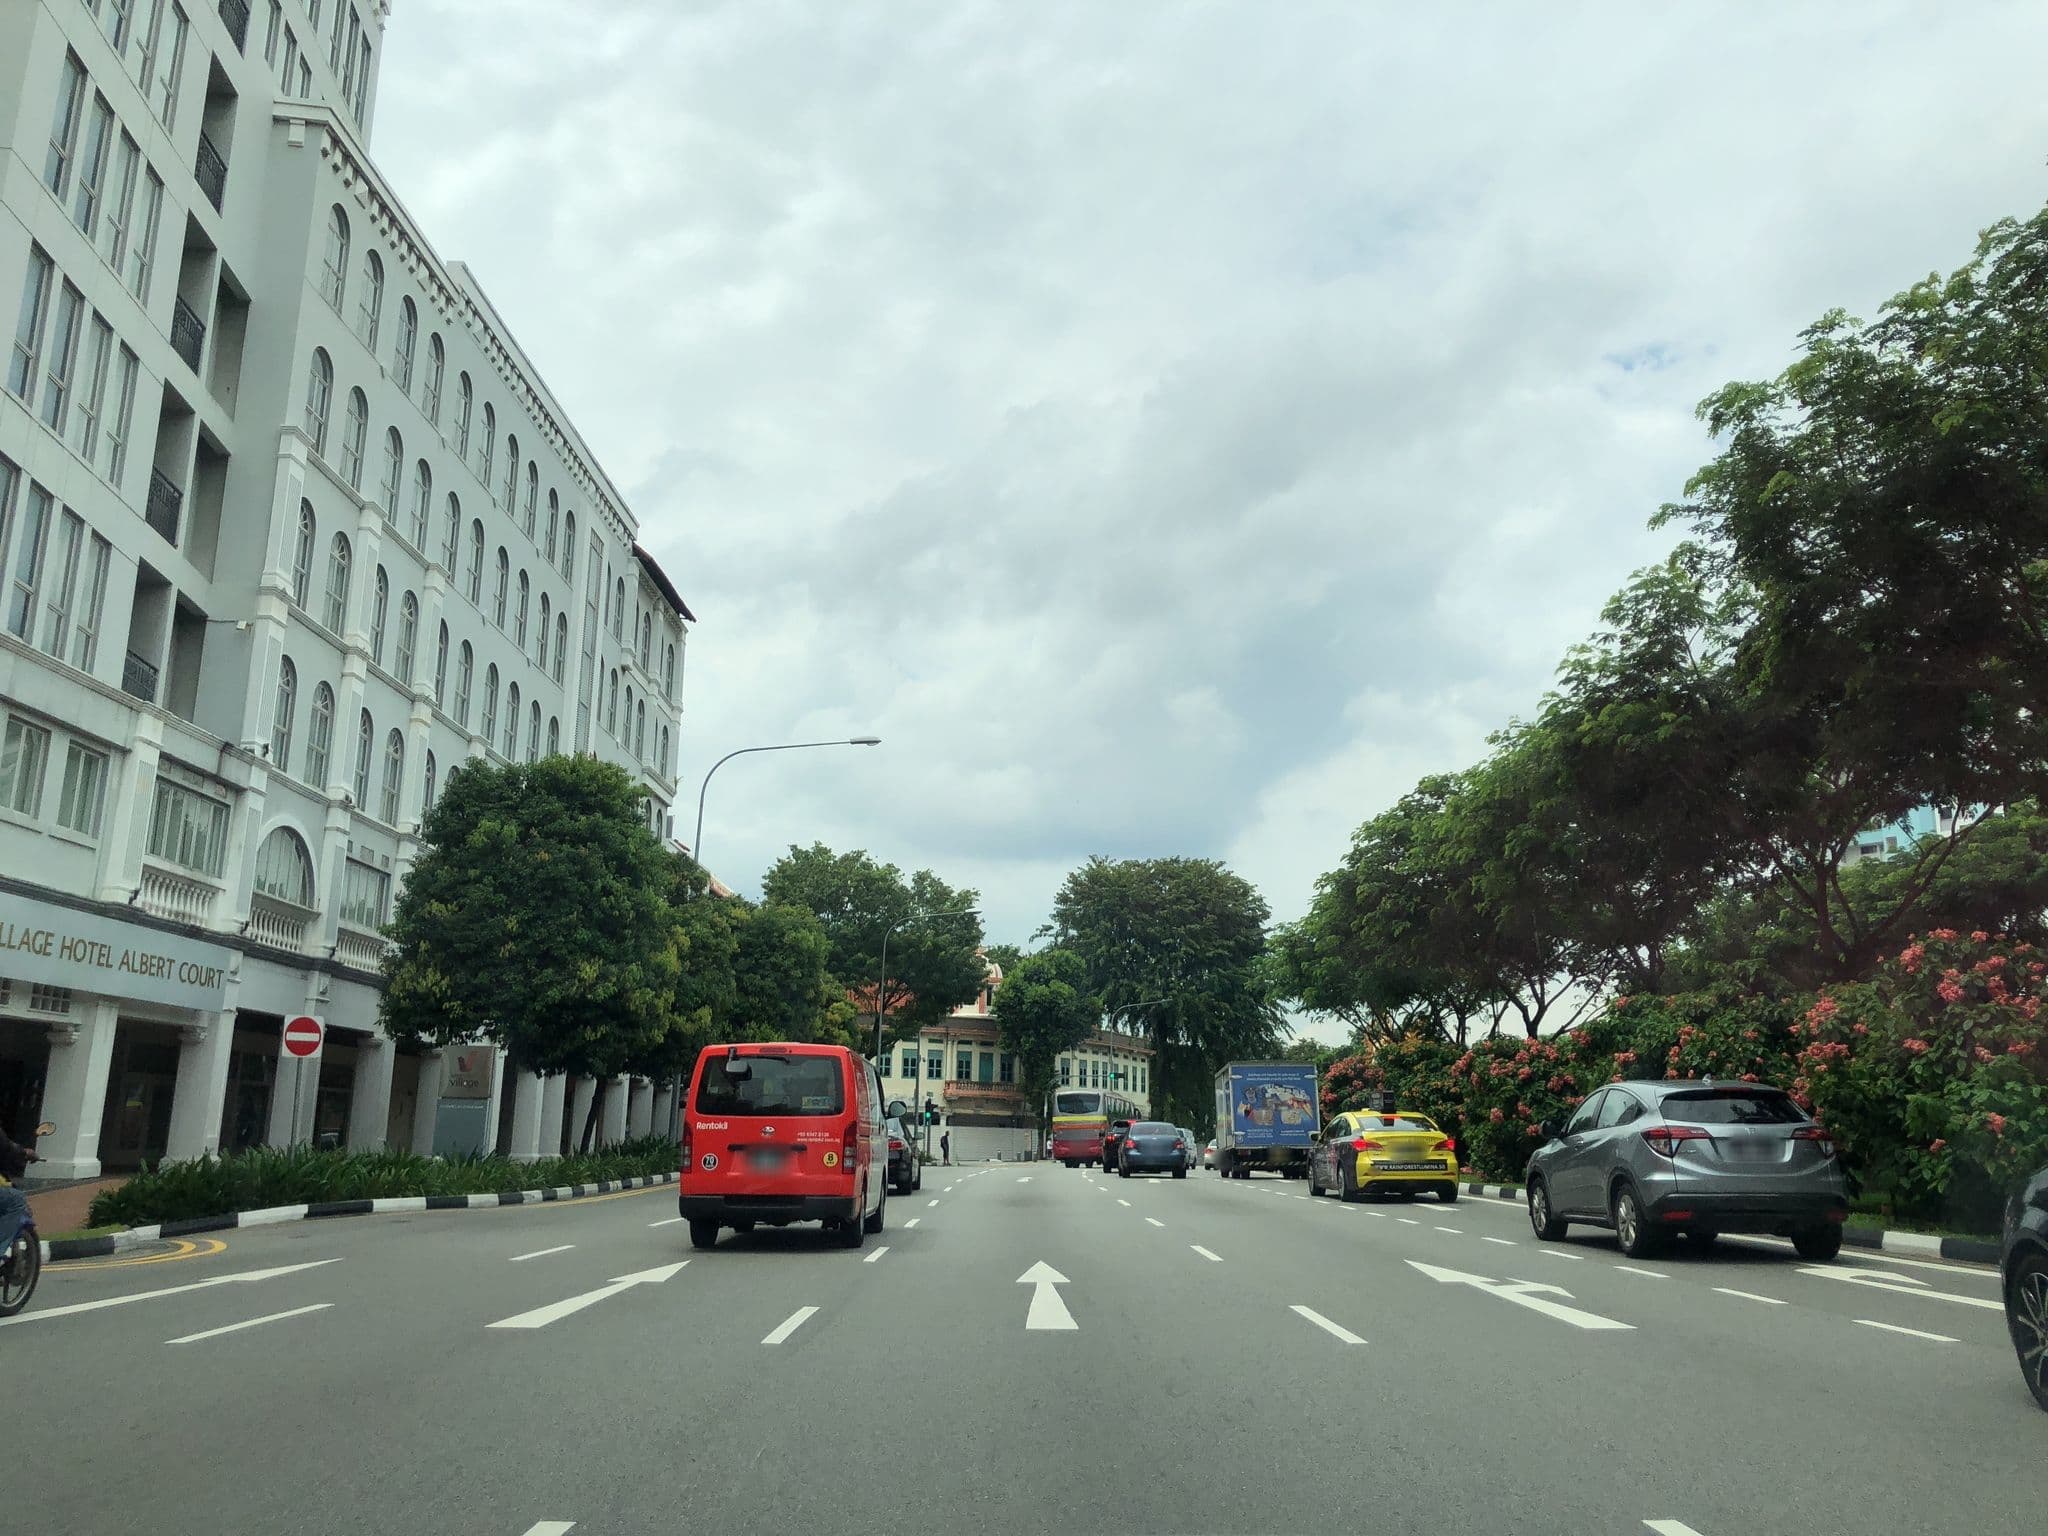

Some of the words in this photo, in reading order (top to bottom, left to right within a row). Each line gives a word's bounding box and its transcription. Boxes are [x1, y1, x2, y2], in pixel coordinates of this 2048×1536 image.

[60, 935, 113, 969] HOTEL
[118, 949, 175, 980] ALBERT
[178, 962, 225, 990] COURT
[696, 1121, 728, 1130] Rentokil
[827, 1153, 834, 1161] 8
